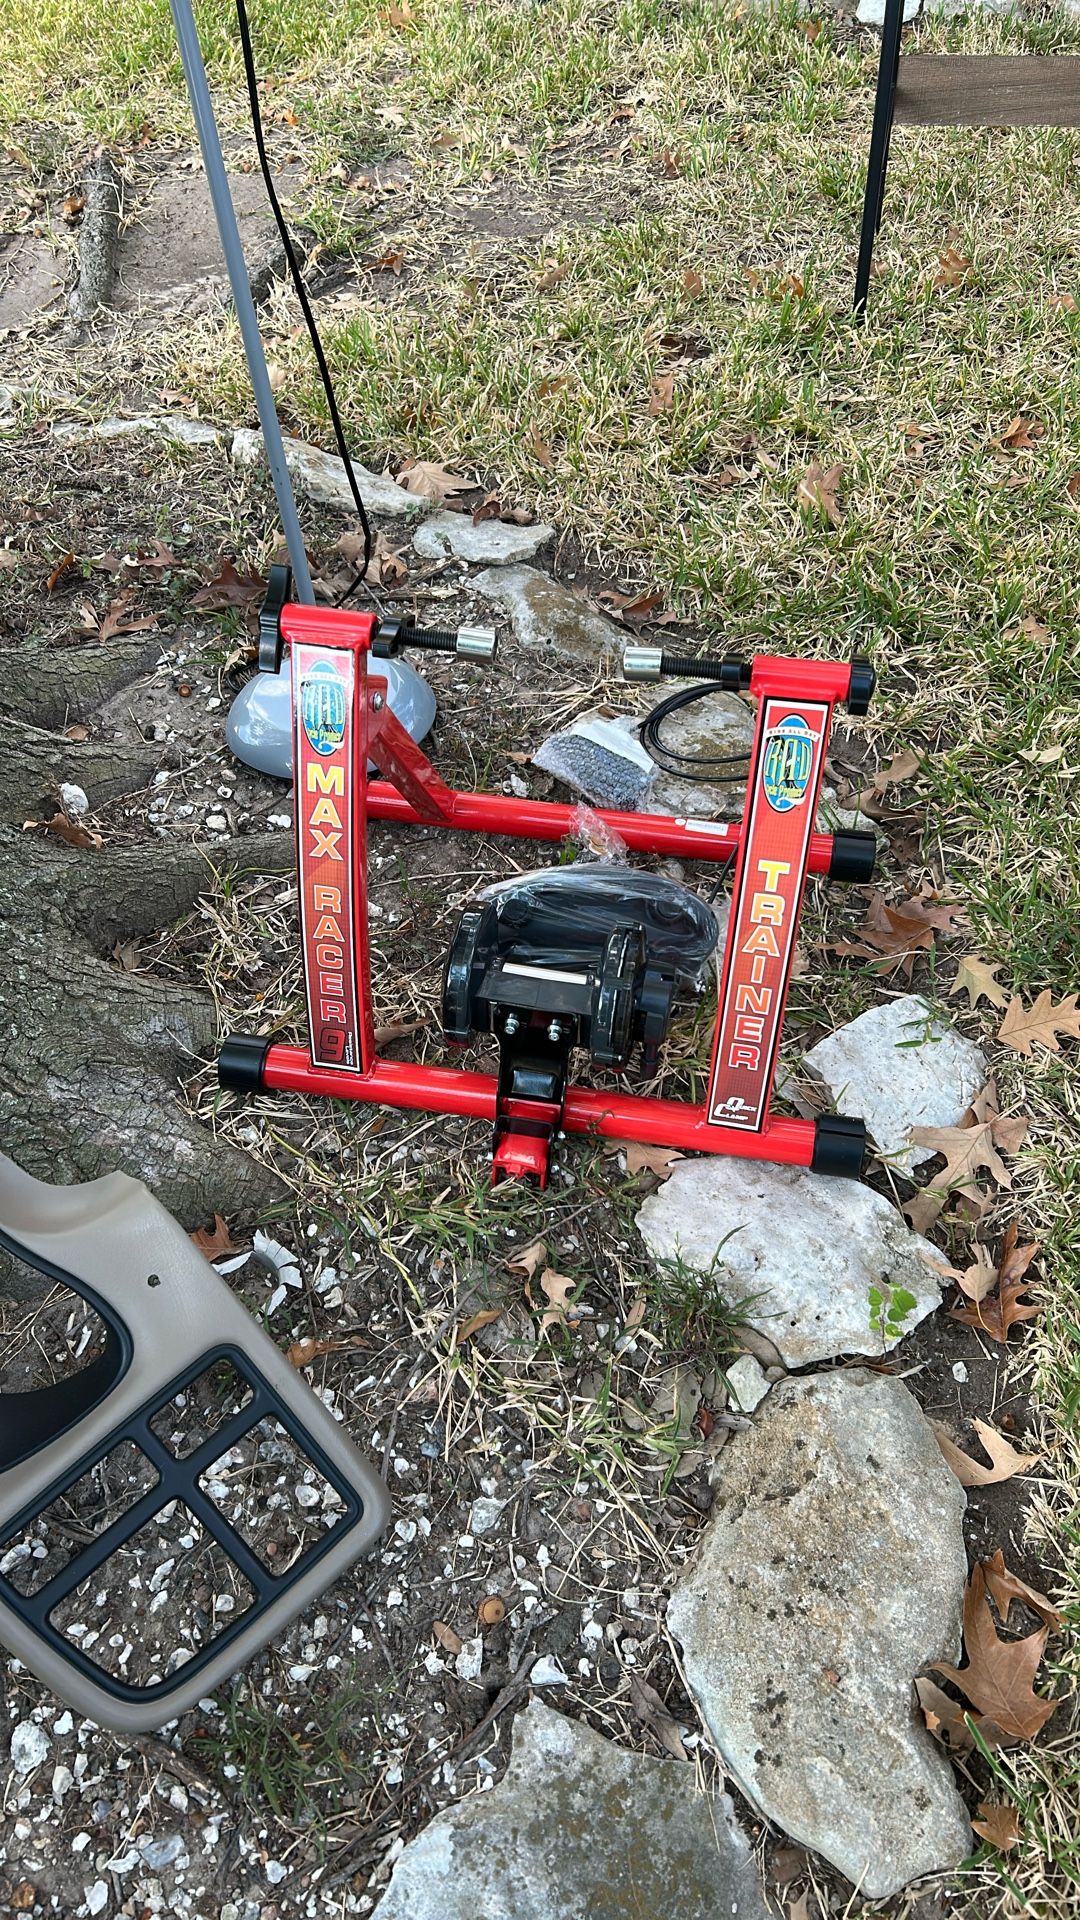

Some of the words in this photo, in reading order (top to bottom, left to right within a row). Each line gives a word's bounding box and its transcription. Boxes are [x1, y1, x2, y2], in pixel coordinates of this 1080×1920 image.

[306, 763, 345, 861] MAX
[312, 884, 347, 1024] RACER
[728, 860, 790, 1070] TRAINER
[321, 1027, 346, 1061] 9
